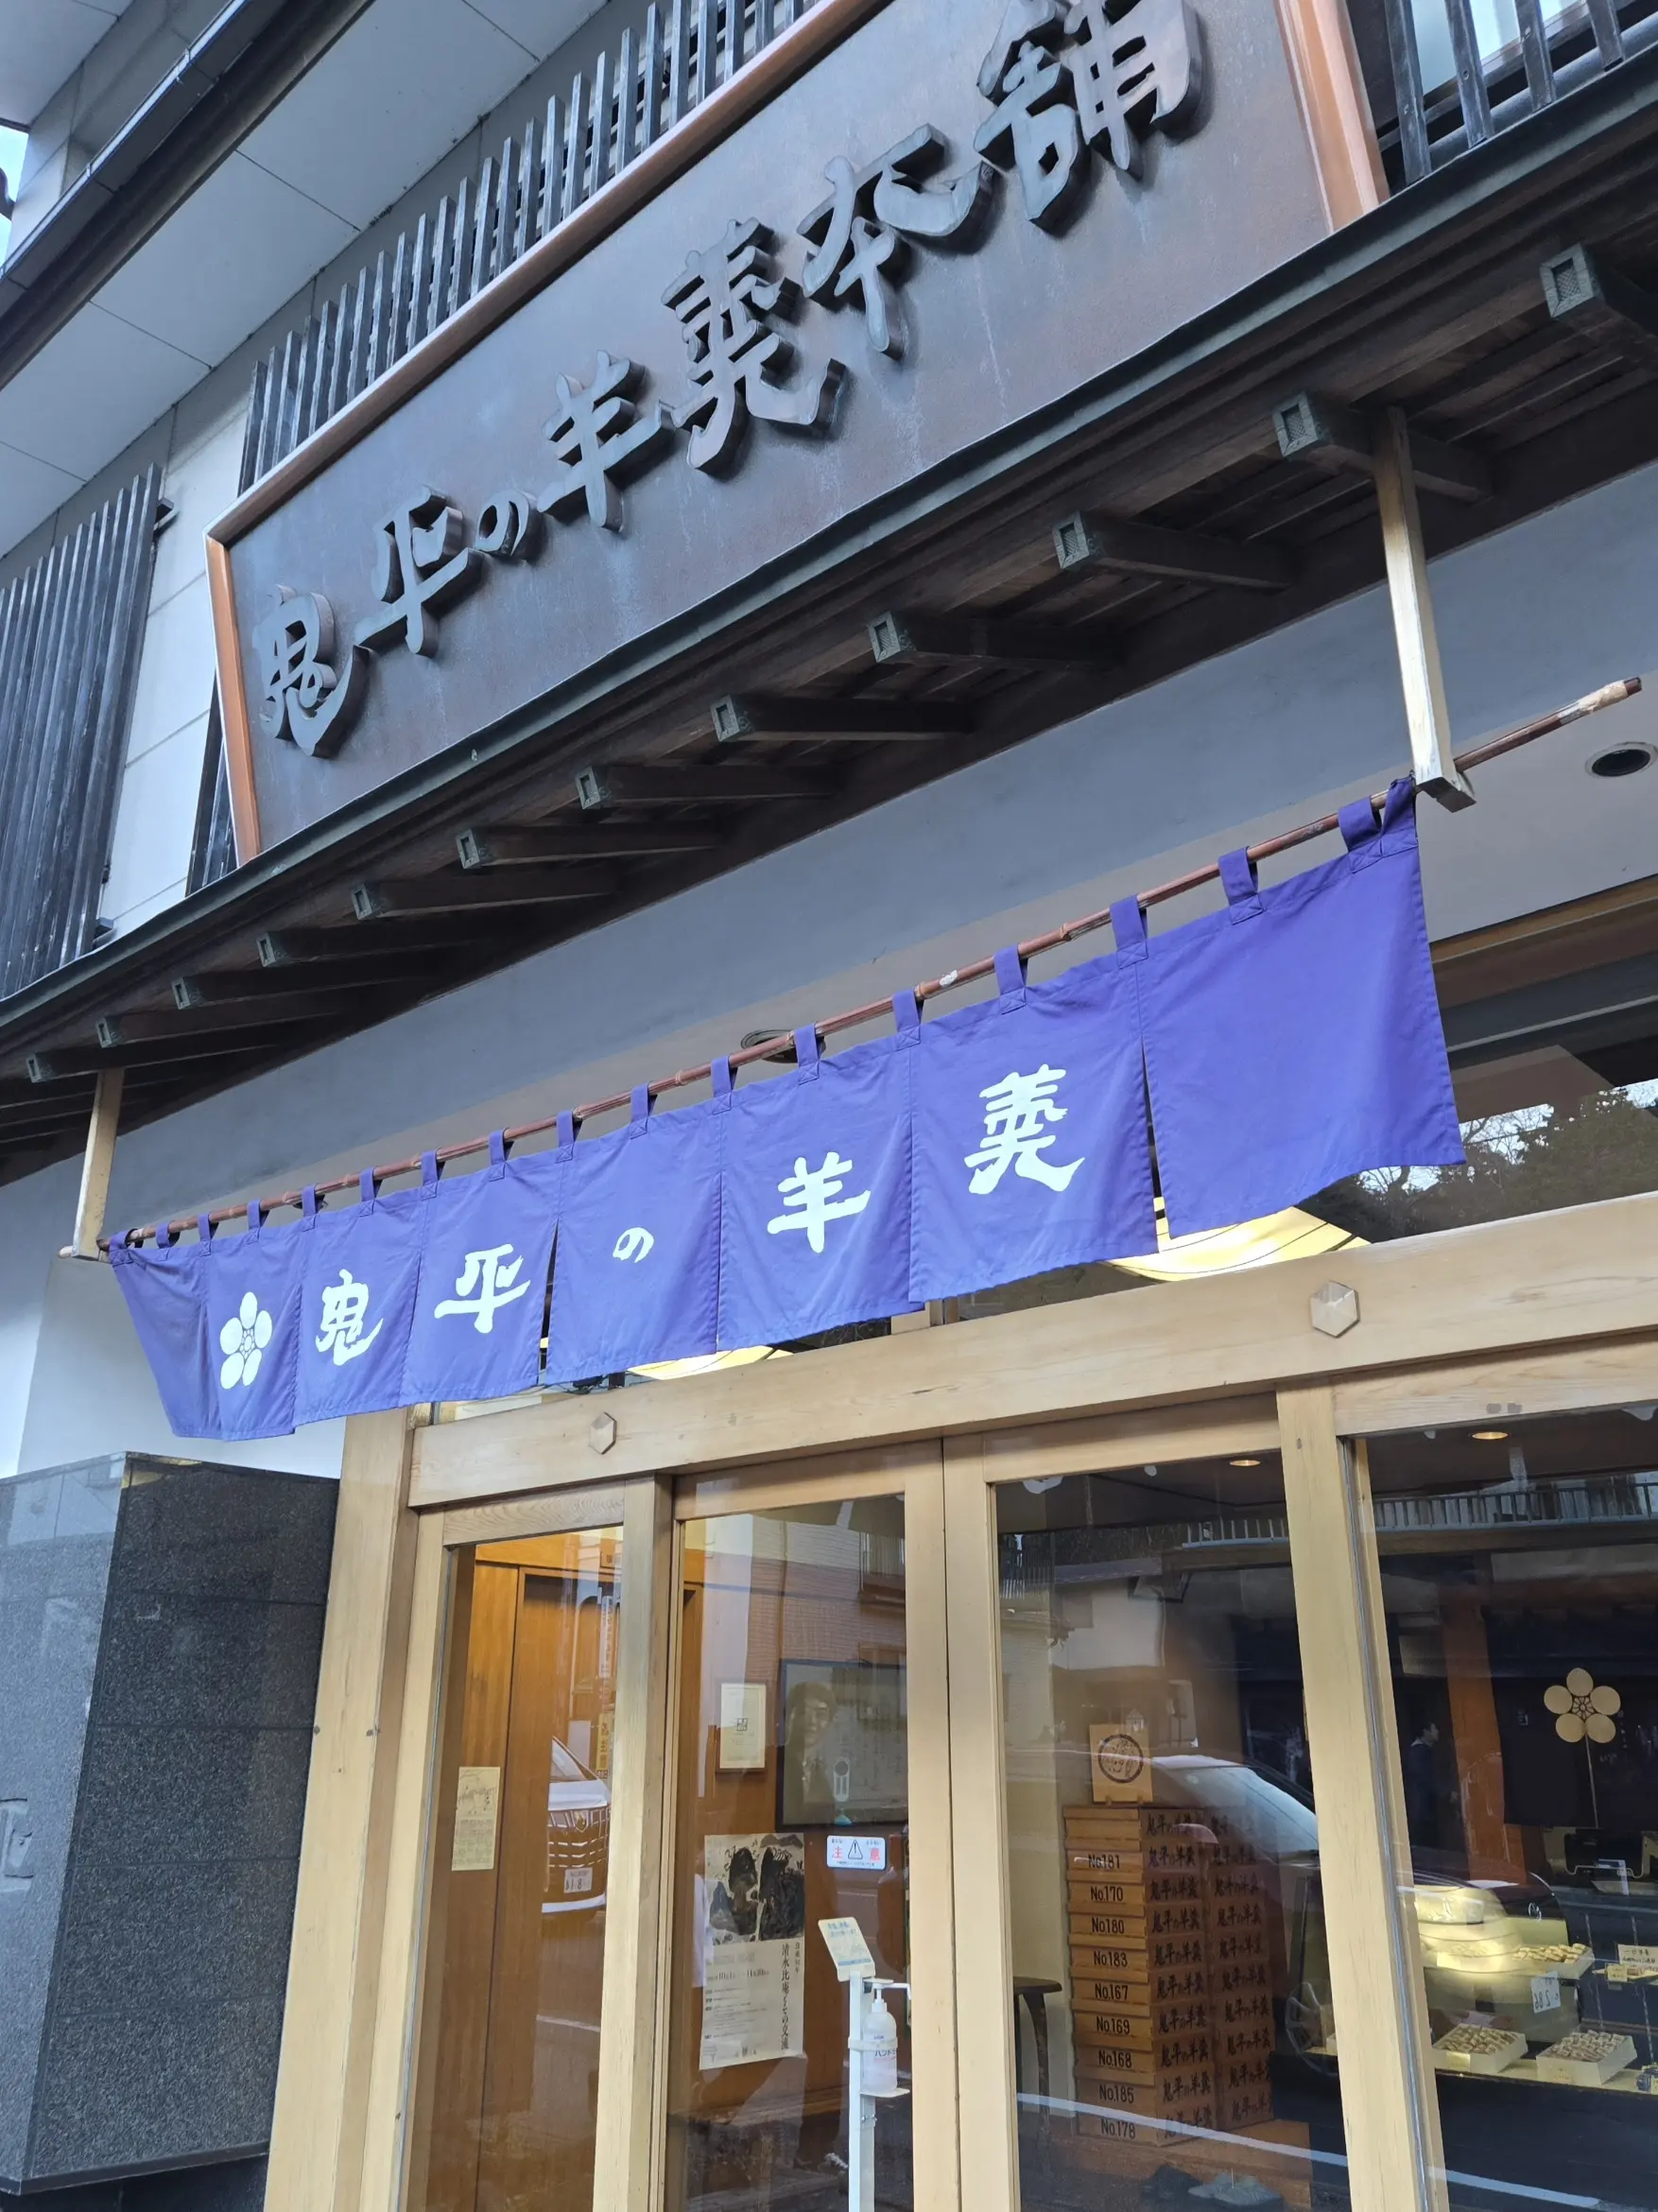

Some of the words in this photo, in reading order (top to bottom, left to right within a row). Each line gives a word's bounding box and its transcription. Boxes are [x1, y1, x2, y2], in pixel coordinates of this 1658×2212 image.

[1088, 1854, 1120, 1869] No.181
[1090, 1885, 1124, 1902] No.170
[1091, 1916, 1125, 1934] No.180
[1093, 1950, 1128, 1968] No.183
[1095, 1983, 1129, 2001] No.167
[1096, 2015, 1131, 2034] No.169
[1097, 2049, 1132, 2068] No.168
